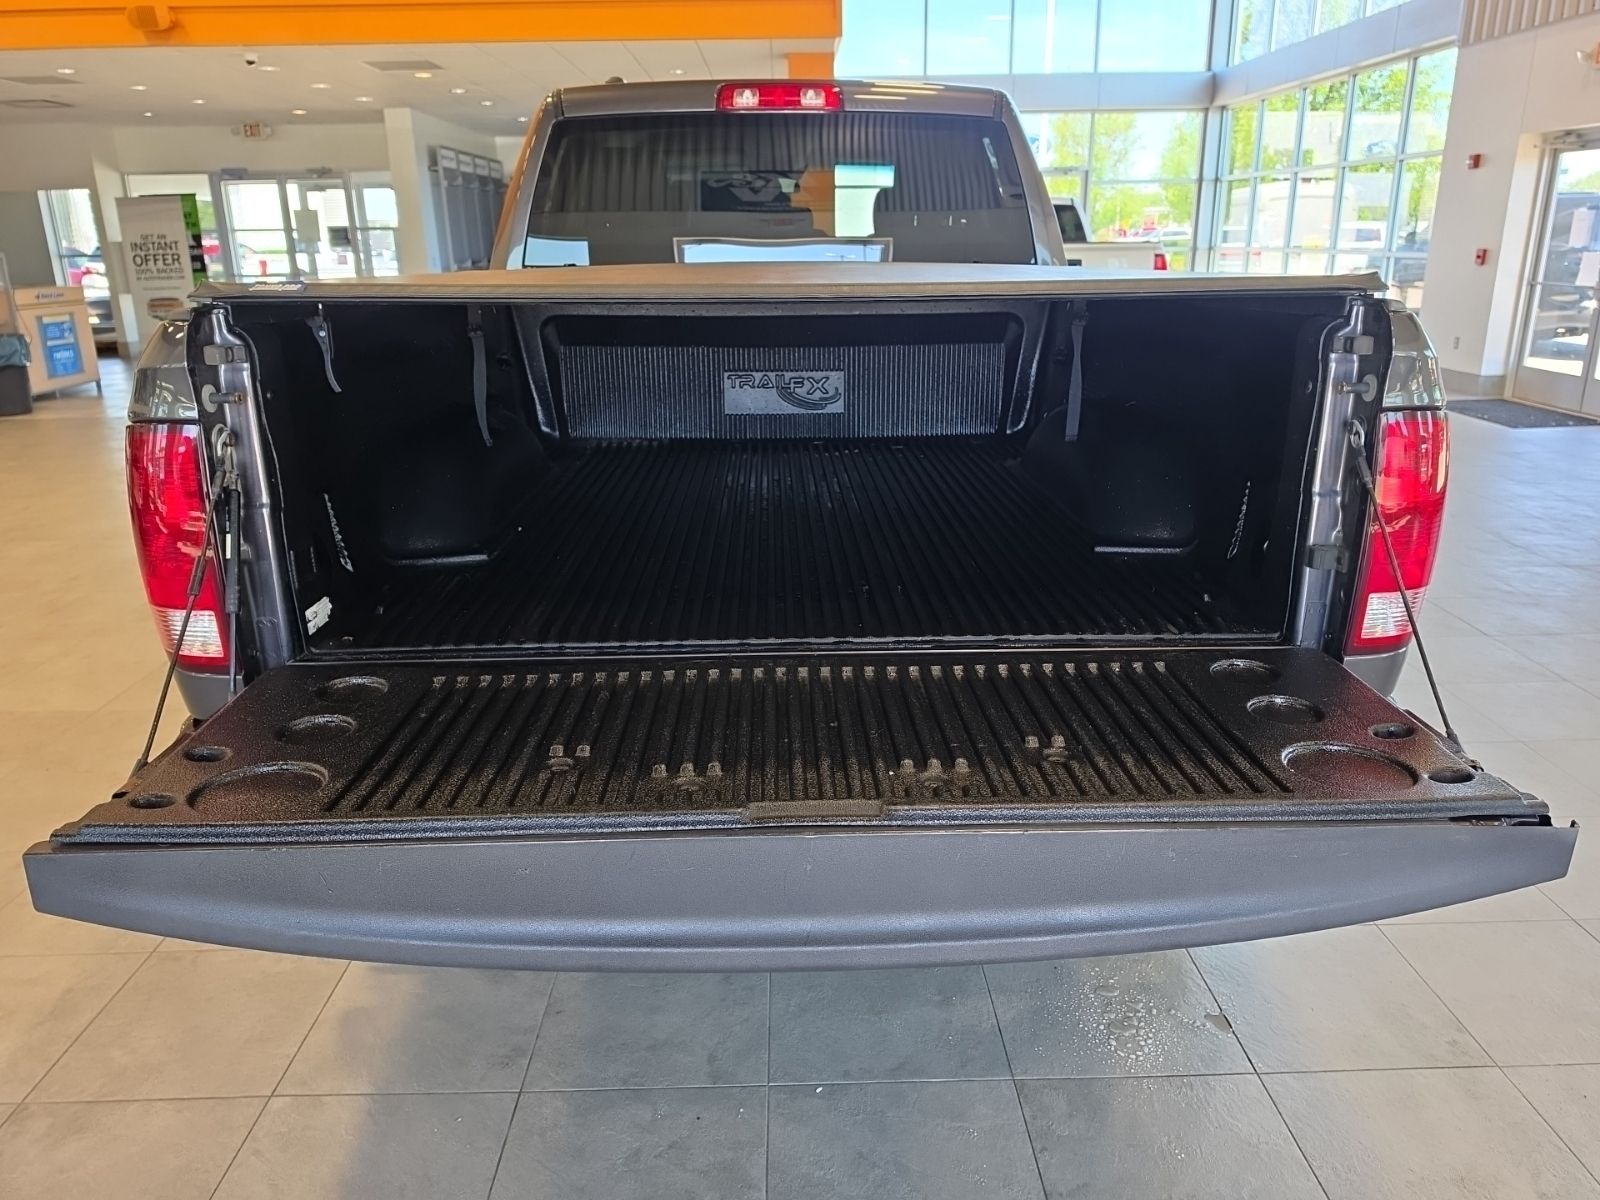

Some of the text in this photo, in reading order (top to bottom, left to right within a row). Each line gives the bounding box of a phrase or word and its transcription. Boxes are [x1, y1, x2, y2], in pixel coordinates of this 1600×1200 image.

[243, 123, 261, 136] EXIT
[140, 233, 154, 241] GET
[130, 241, 179, 253] INSTANT
[132, 252, 182, 267] OFFER
[727, 373, 830, 395] TRAILFX
